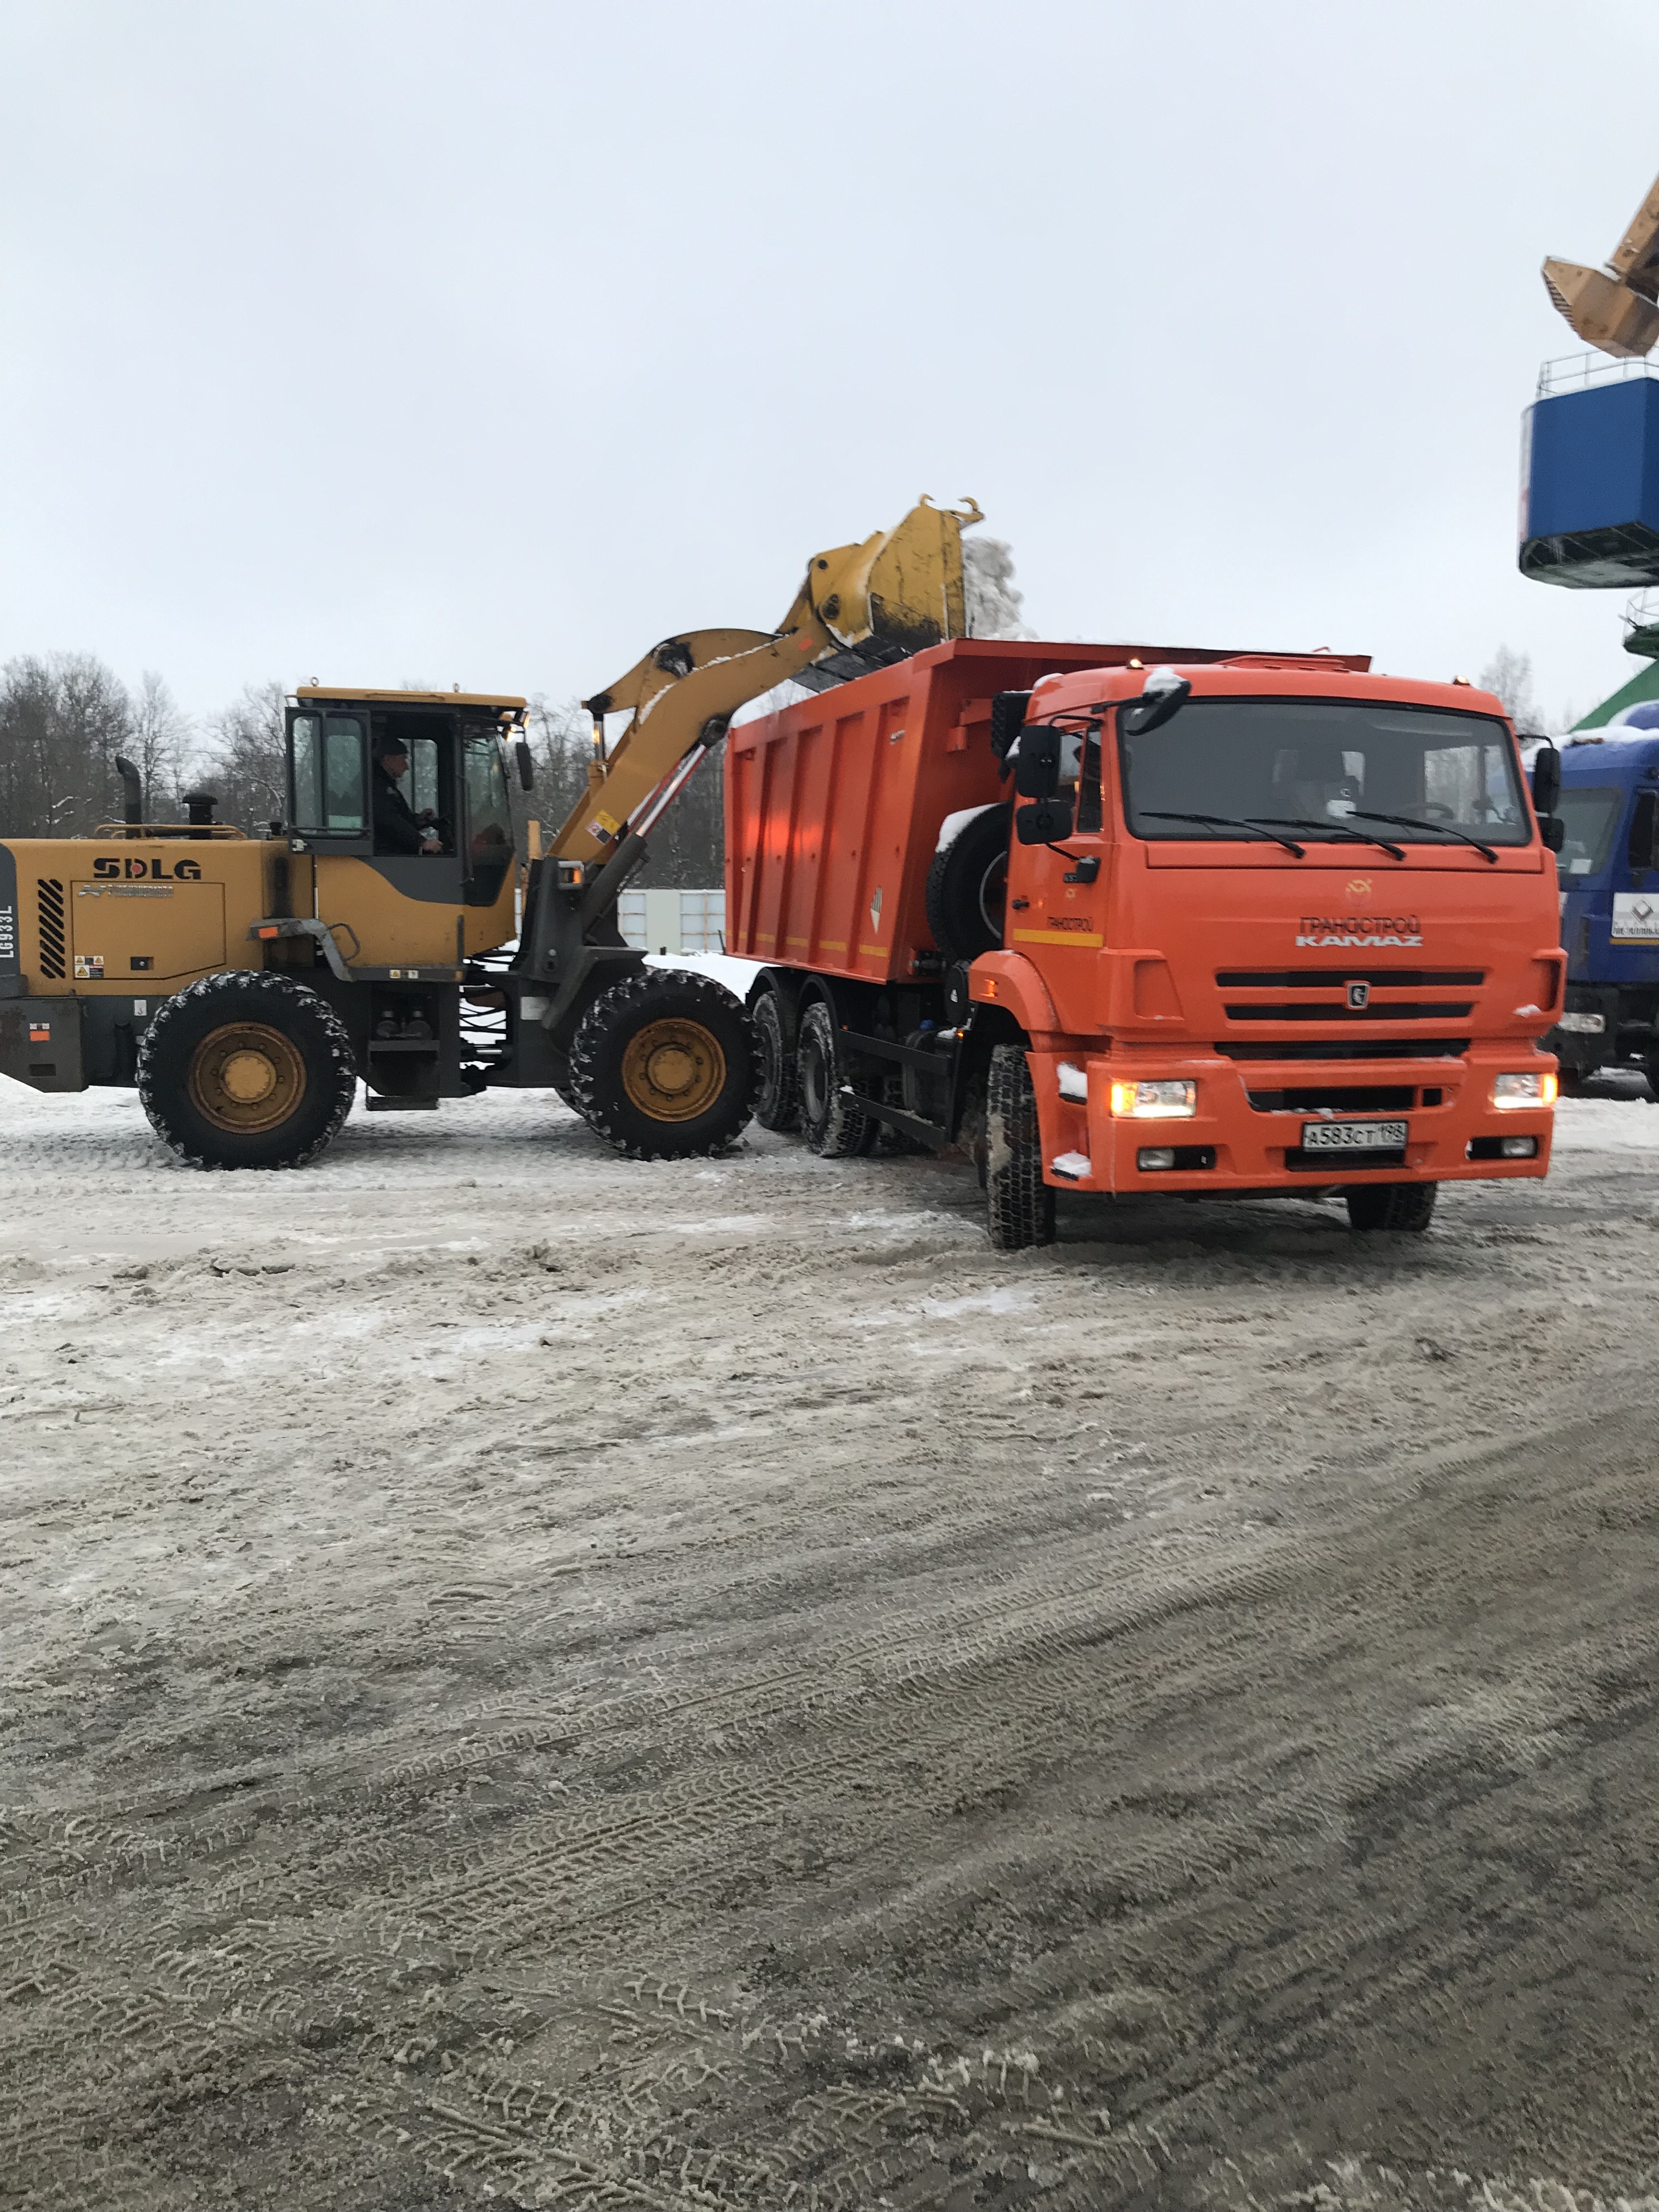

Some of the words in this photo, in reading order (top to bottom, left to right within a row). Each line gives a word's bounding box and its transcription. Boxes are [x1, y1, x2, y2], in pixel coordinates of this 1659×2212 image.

[93, 857, 201, 880] SDLG
[0, 906, 14, 958] LG933L
[1295, 935, 1424, 947] KAMAZ
